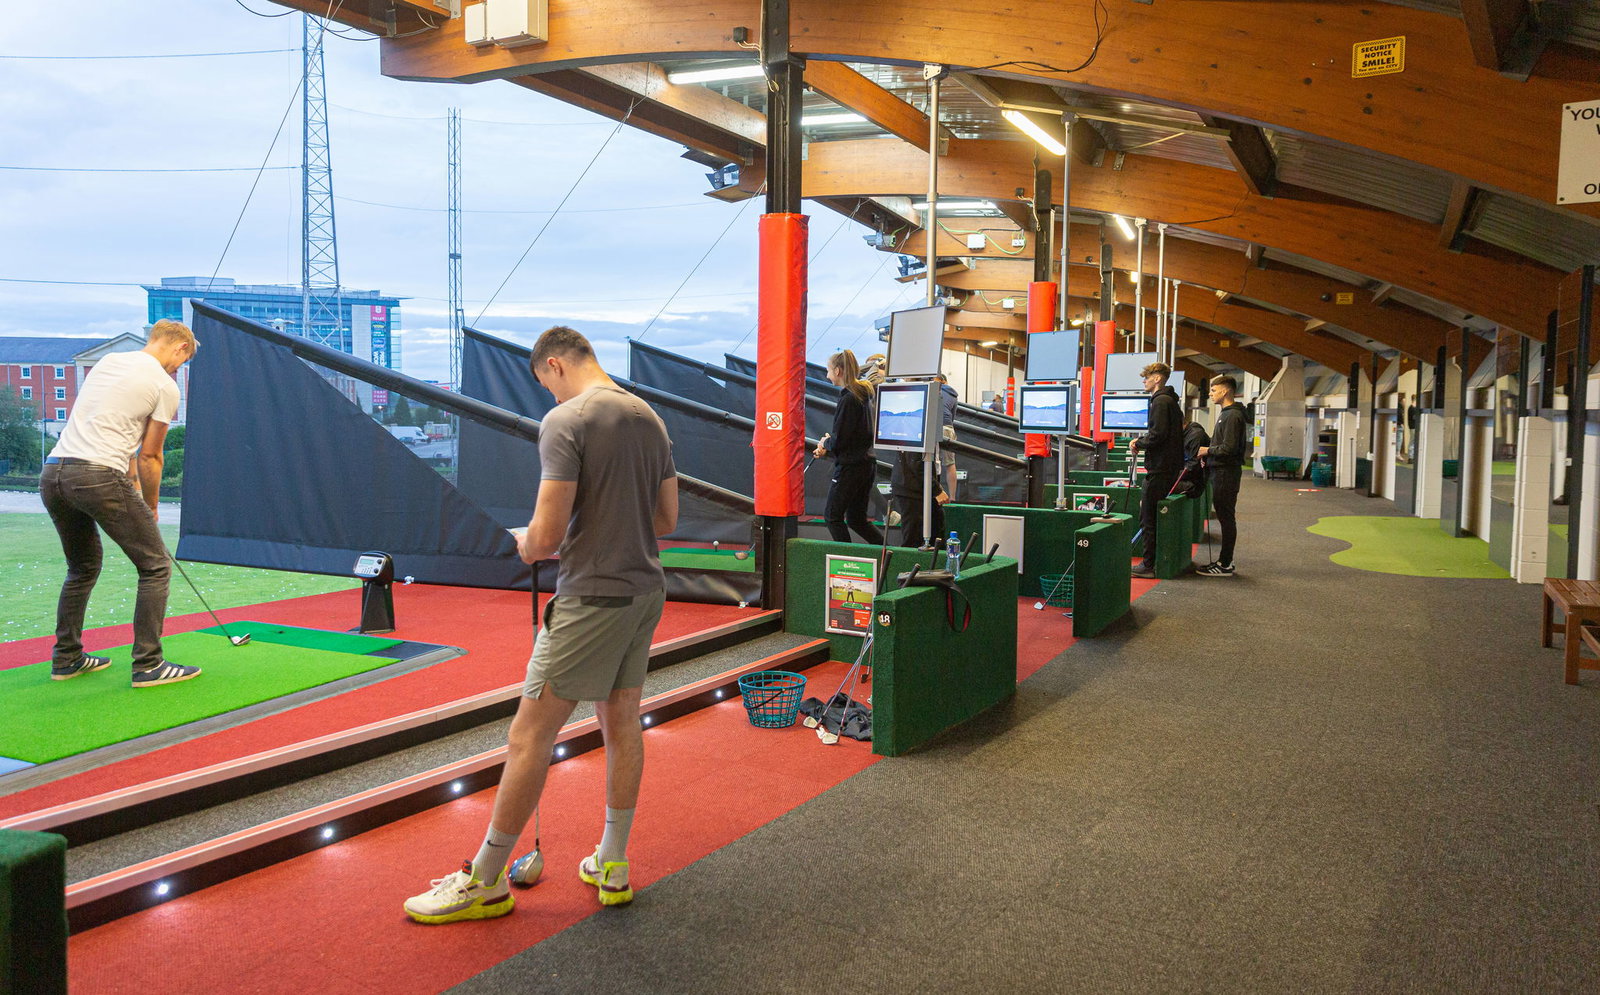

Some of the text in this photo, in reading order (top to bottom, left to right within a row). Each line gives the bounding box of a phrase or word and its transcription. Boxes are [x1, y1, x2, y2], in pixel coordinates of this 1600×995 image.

[1361, 43, 1397, 53] SECURITY
[1364, 50, 1393, 59] NOTICE
[1362, 56, 1395, 68] SMILE!
[1077, 539, 1089, 548] 49
